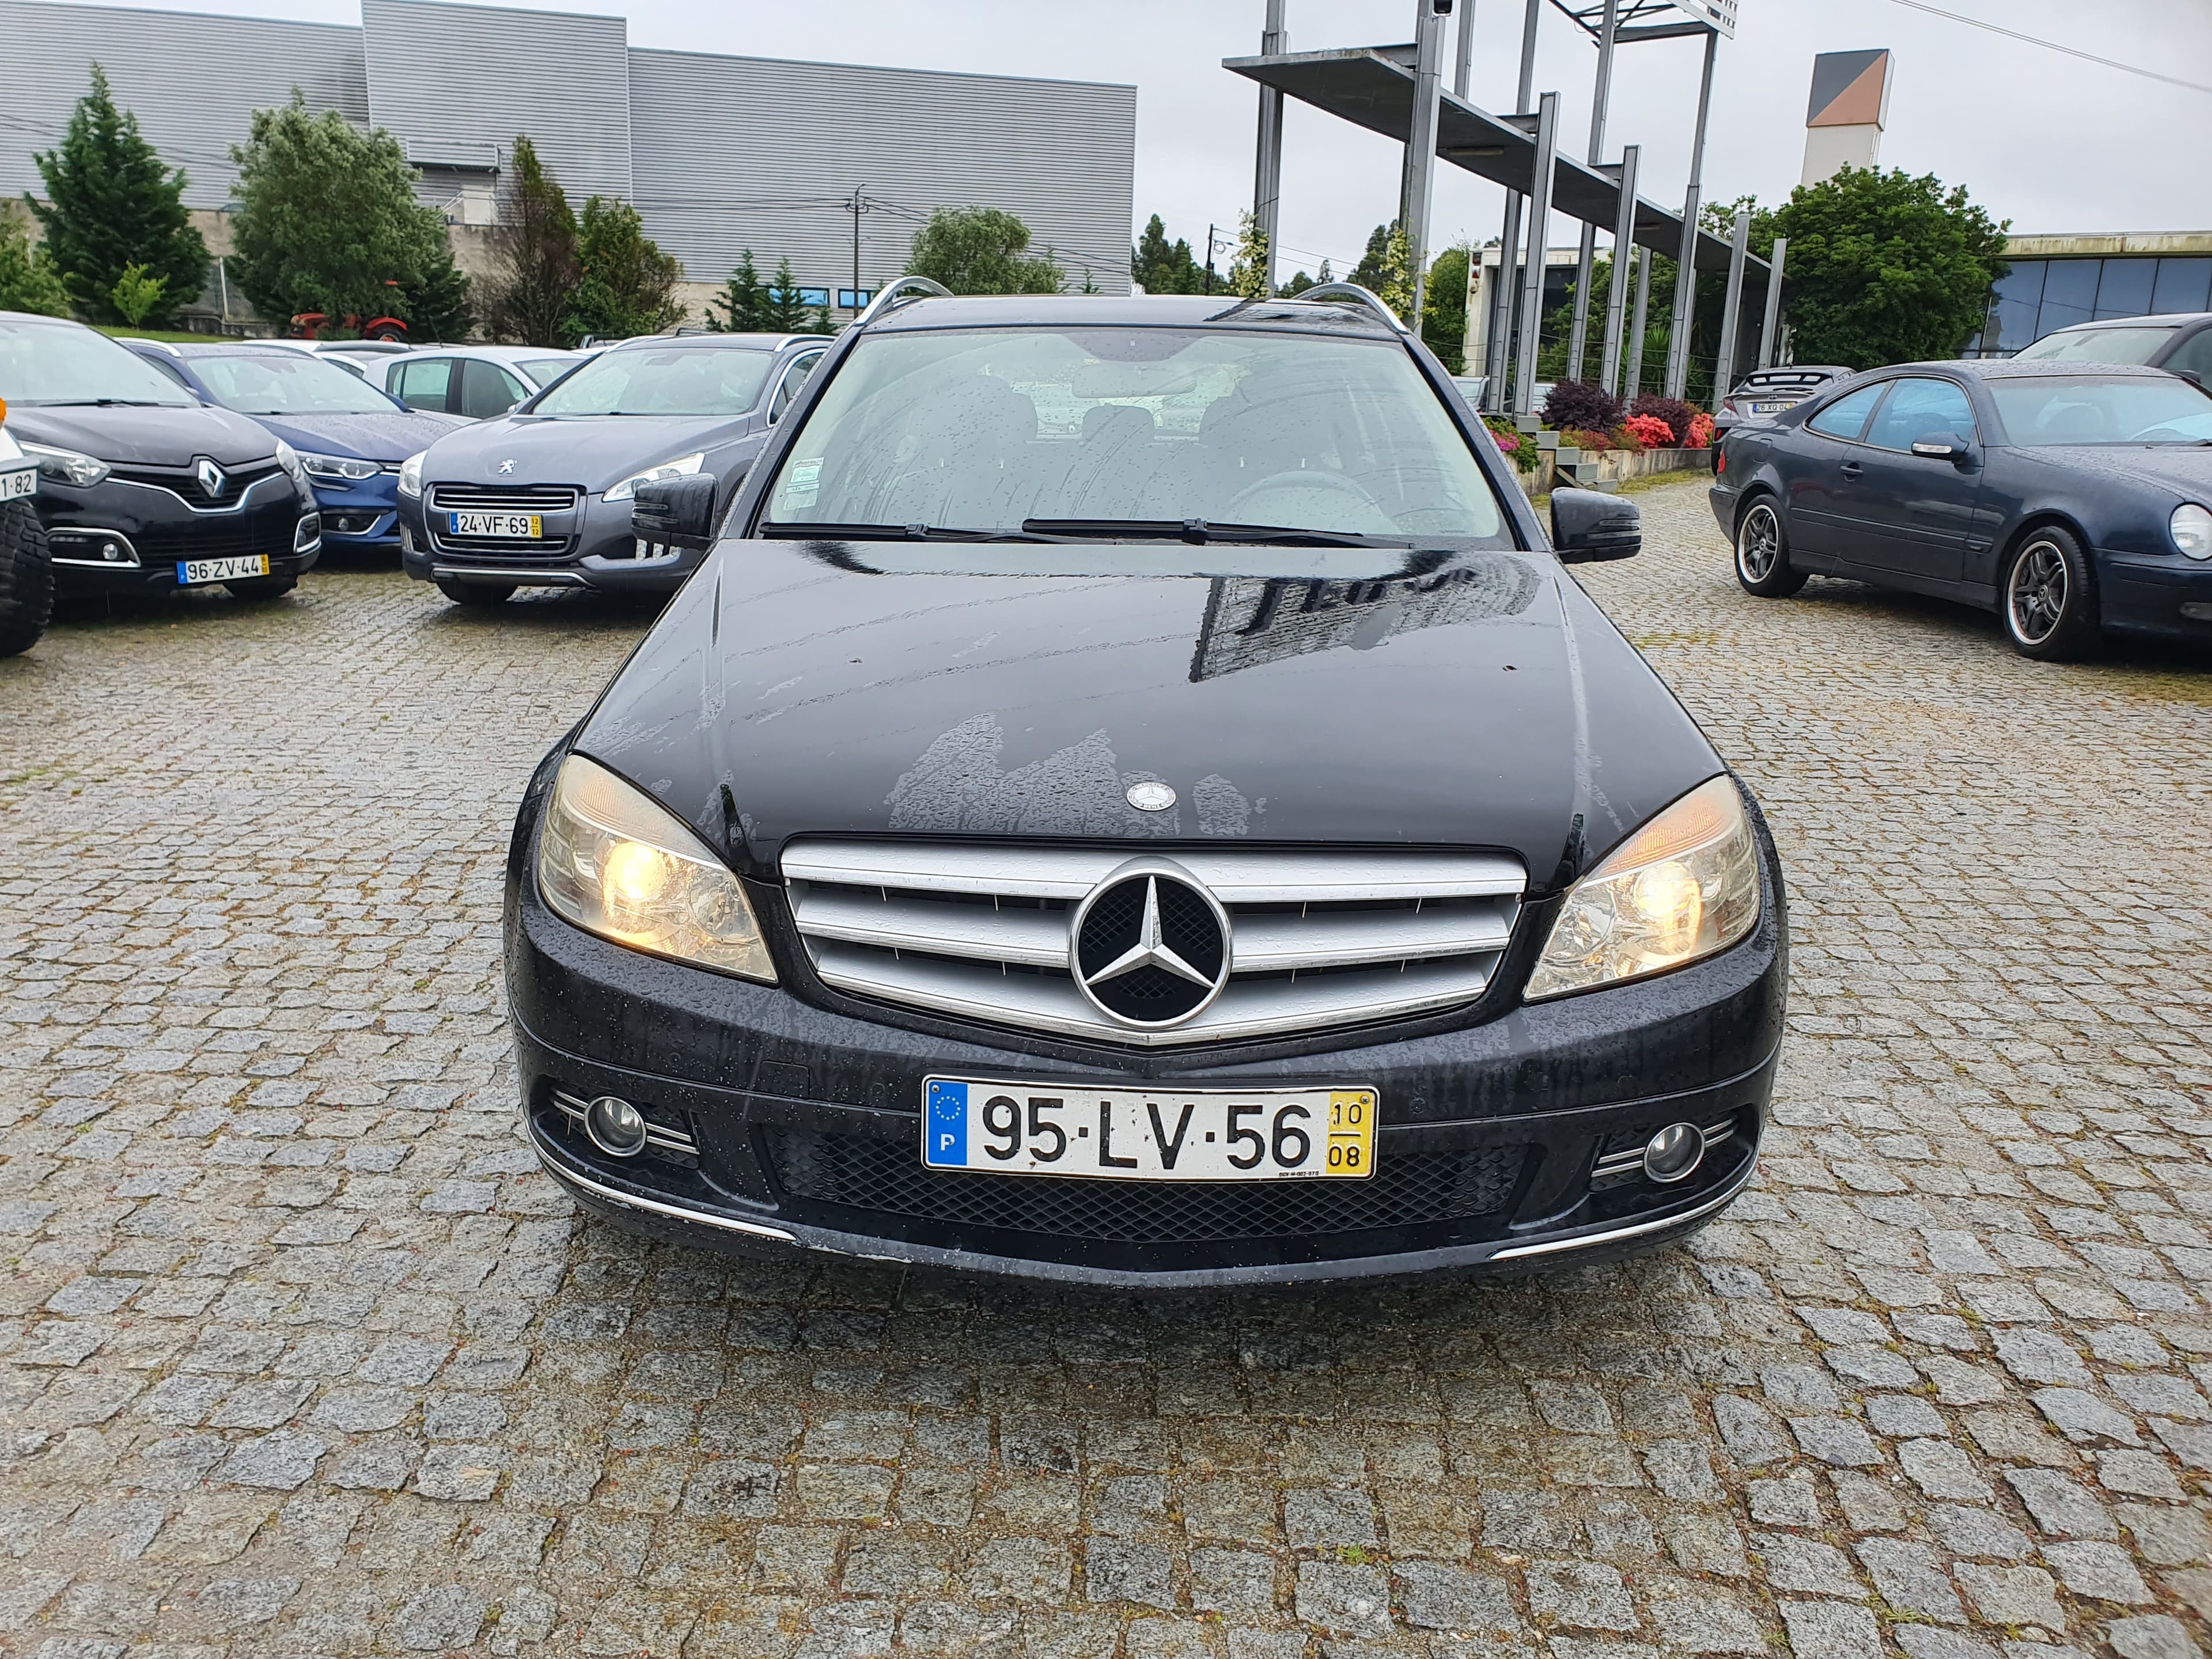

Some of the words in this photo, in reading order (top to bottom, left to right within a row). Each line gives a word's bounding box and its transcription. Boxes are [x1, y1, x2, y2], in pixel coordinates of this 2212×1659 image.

[1334, 1104, 1362, 1124] 10
[982, 1095, 1312, 1169] 95·LV·56
[940, 1134, 955, 1151] P
[1328, 1146, 1359, 1166] 08
